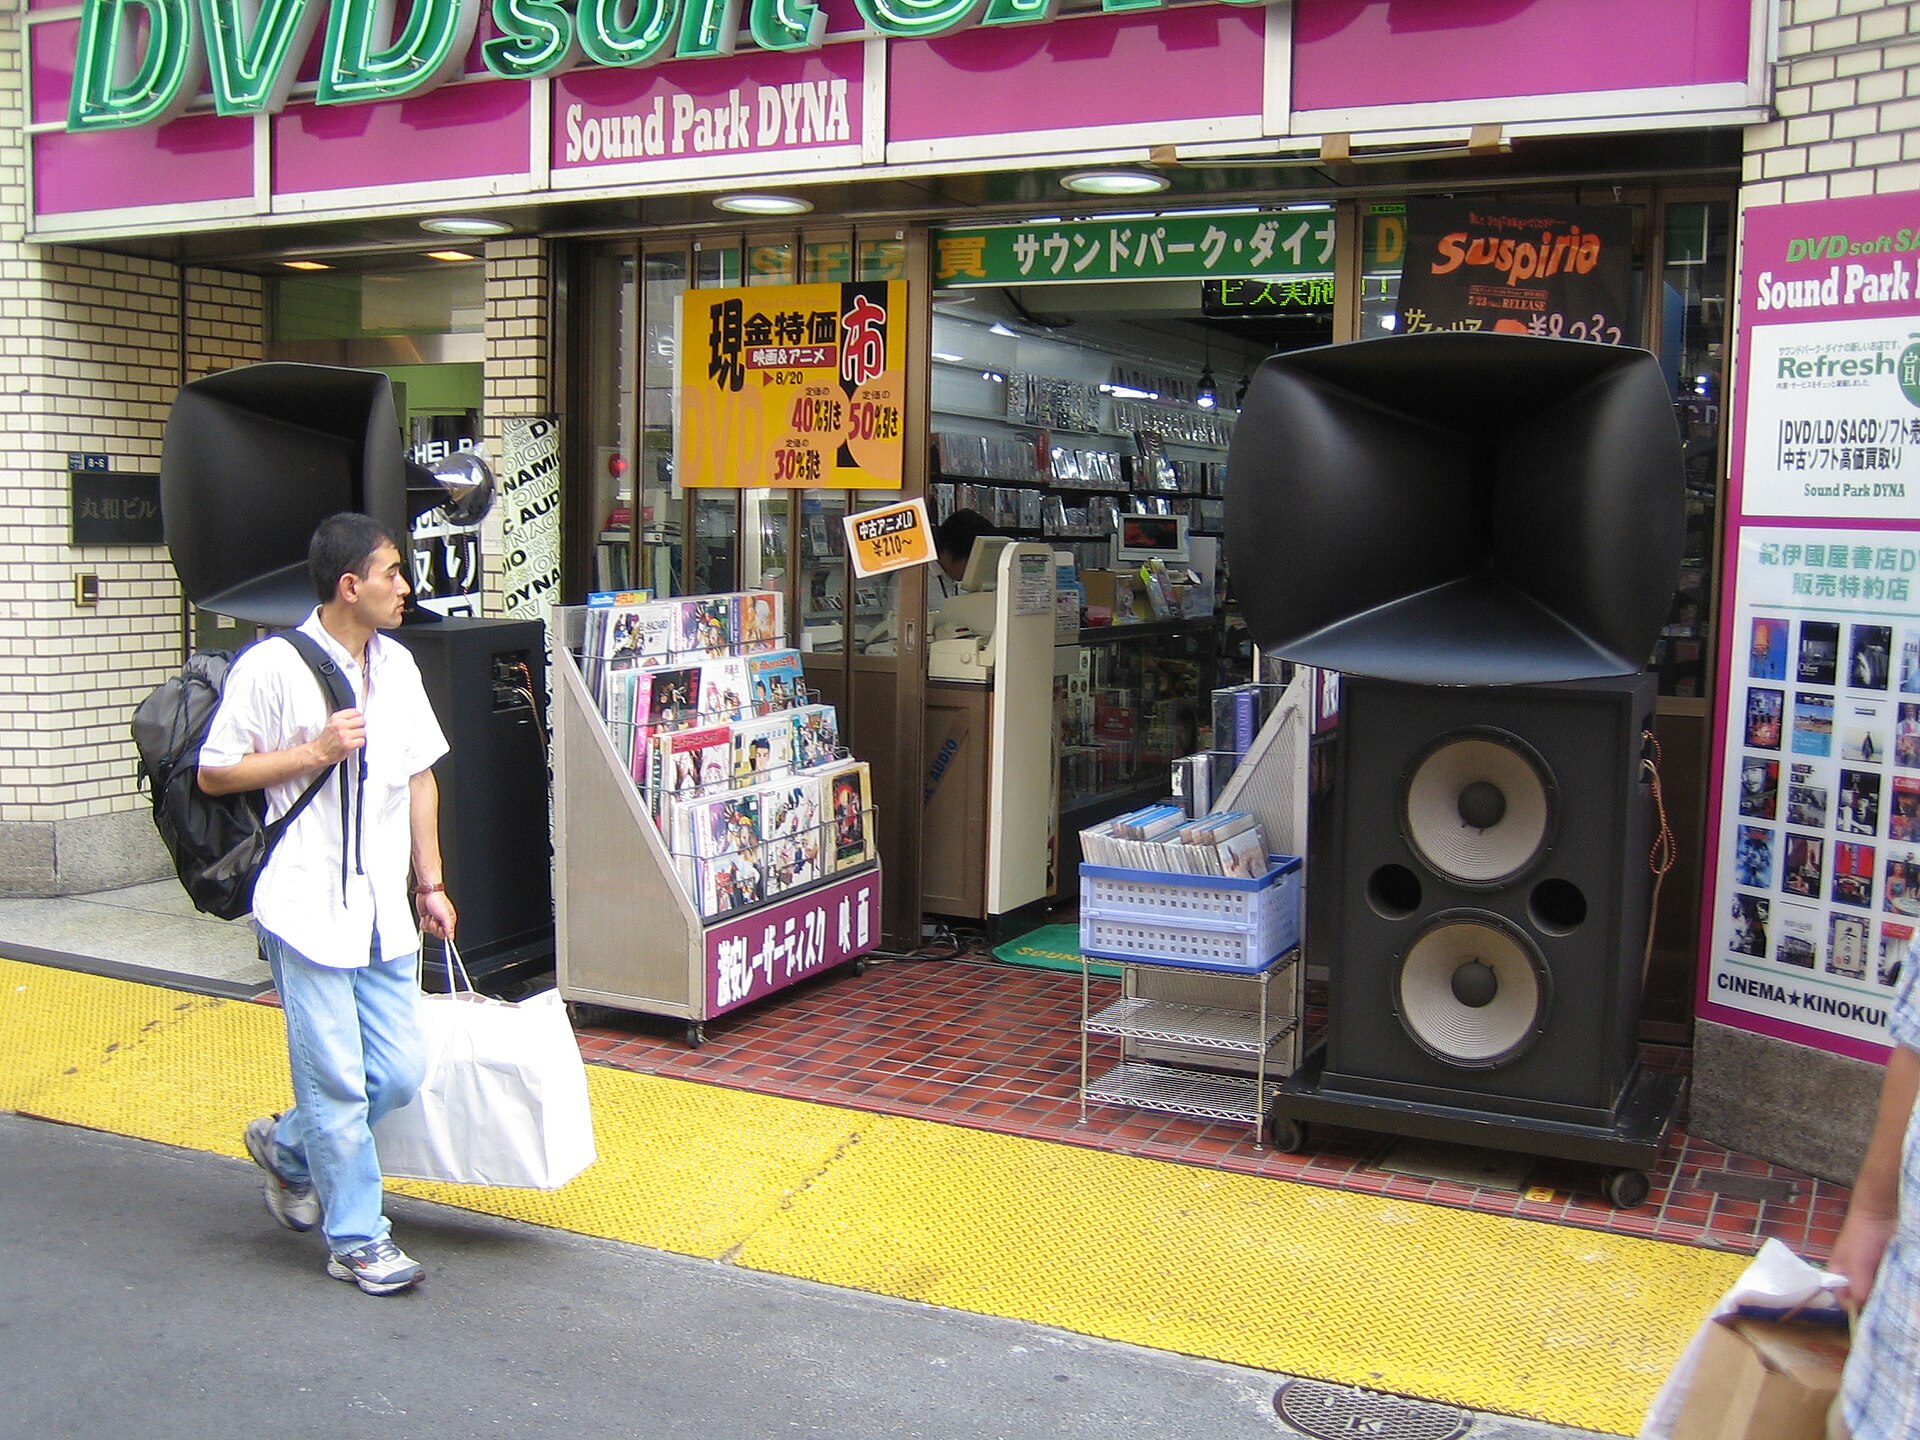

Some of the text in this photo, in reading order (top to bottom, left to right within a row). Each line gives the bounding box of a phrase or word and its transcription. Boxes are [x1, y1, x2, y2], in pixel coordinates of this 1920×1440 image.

[566, 79, 848, 161] Sound Park DYNA
[1431, 226, 1600, 286] Suspiria
[1786, 235, 1848, 262] DVD
[1849, 236, 1893, 256] soft
[1757, 265, 1840, 311] Sound
[1844, 260, 1910, 305] Park
[775, 371, 804, 385] 8/20
[1777, 352, 1895, 379] Refresh
[1783, 447, 1902, 471] 中古ソフト高価買取り
[1804, 483, 1906, 497] Sound Park DYNA
[80, 496, 157, 520] 丸和ビル
[859, 510, 913, 540] 中古アニメLD
[1758, 542, 1920, 572] 紀伊國屋書店D
[1792, 572, 1910, 601] 販売特約店
